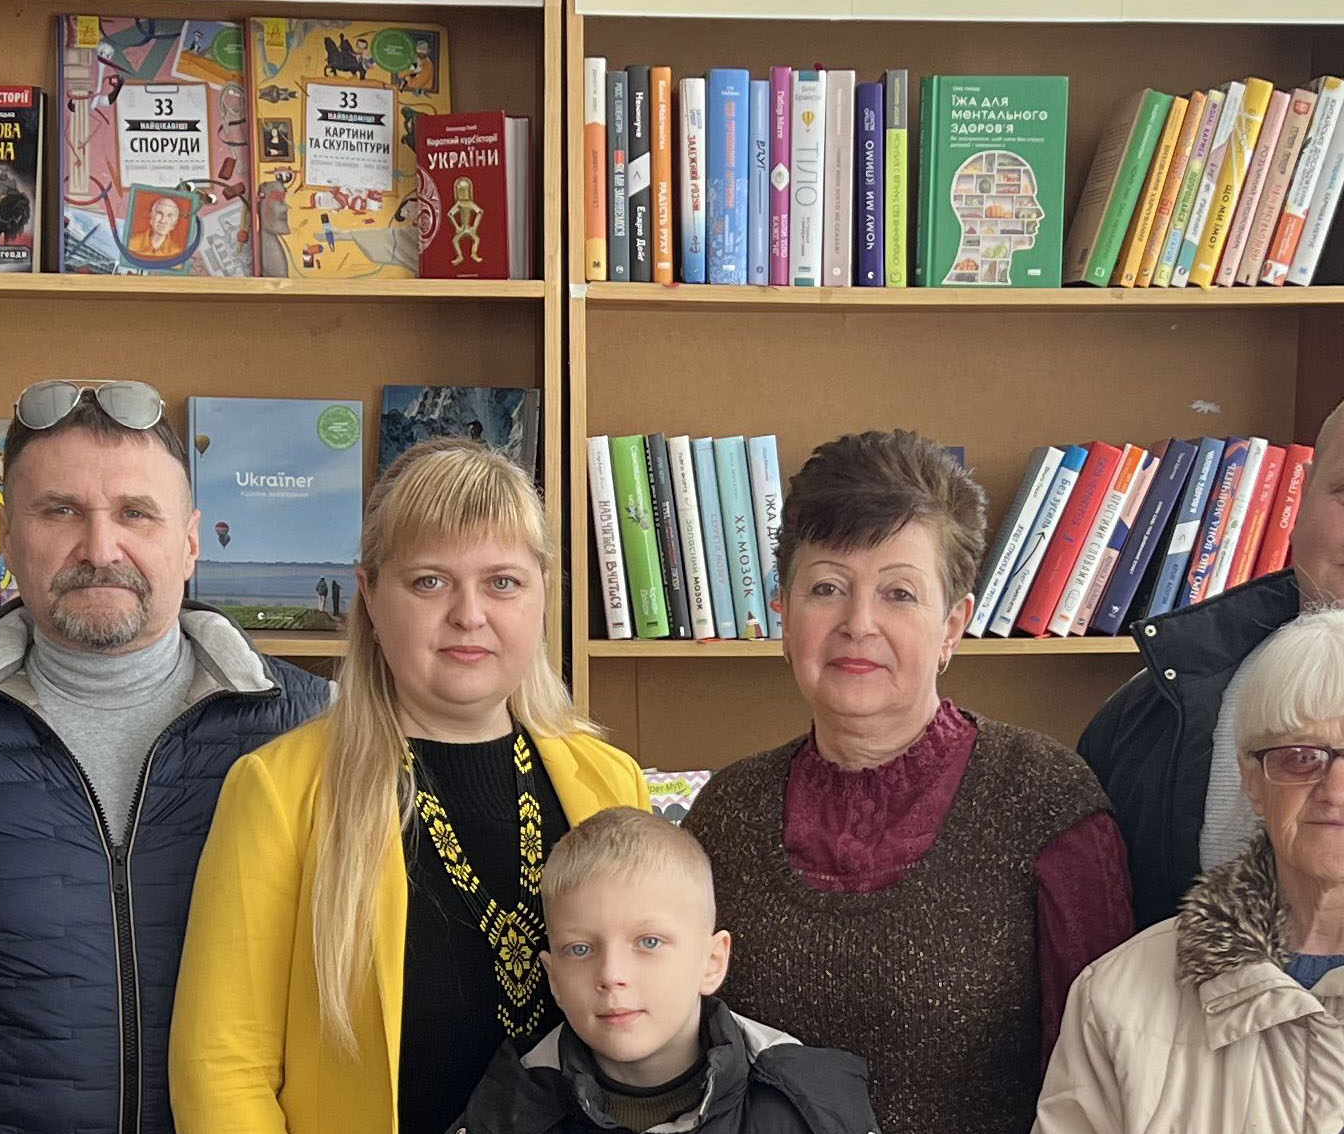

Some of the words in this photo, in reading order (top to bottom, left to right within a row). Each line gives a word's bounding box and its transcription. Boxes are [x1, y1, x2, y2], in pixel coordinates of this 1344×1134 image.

[155, 98, 173, 116] 33
[340, 92, 358, 108] 33
[952, 94, 977, 106] ЇЖА
[981, 97, 1008, 108] ДЛЯ
[140, 122, 188, 130] НАЙЦІКАВІШІ
[952, 110, 1048, 120] МЕНТАЛЬНОГО
[1316, 98, 1337, 146] КИТАЙСЬКЕ
[325, 126, 374, 141] КАРТИНИ
[951, 124, 1013, 134] ЗДОРОВ'Я
[130, 138, 200, 156] СПОРУДИ
[309, 138, 320, 149] ТА
[323, 139, 390, 155] СКУЛЬПТУРИ
[427, 137, 459, 146] Короткий
[428, 147, 498, 169] УКРАЇНИ
[794, 142, 818, 206] ТІЛО
[1296, 146, 1321, 207] ДОСЛІДЖЕННЯ
[658, 182, 667, 225] РАДІСТЬ
[865, 190, 874, 210] МИ
[1220, 183, 1233, 205] ЩО
[1214, 204, 1227, 223] МИ
[659, 228, 667, 254] РУХУ
[865, 215, 874, 249] ЧОМУ
[236, 472, 314, 487] Ukraïner
[1055, 476, 1071, 497] Без
[1210, 460, 1240, 519] МОВЧИТЬ
[763, 493, 780, 521] ЇЖА
[1040, 495, 1061, 531] зусиль
[1094, 492, 1120, 540] ПРОСТИМИ
[1202, 518, 1223, 551] ВОНА
[1074, 540, 1099, 586] СЛОВАМИ
[1196, 551, 1210, 573] ЩО
[1188, 574, 1204, 599] ПРО
